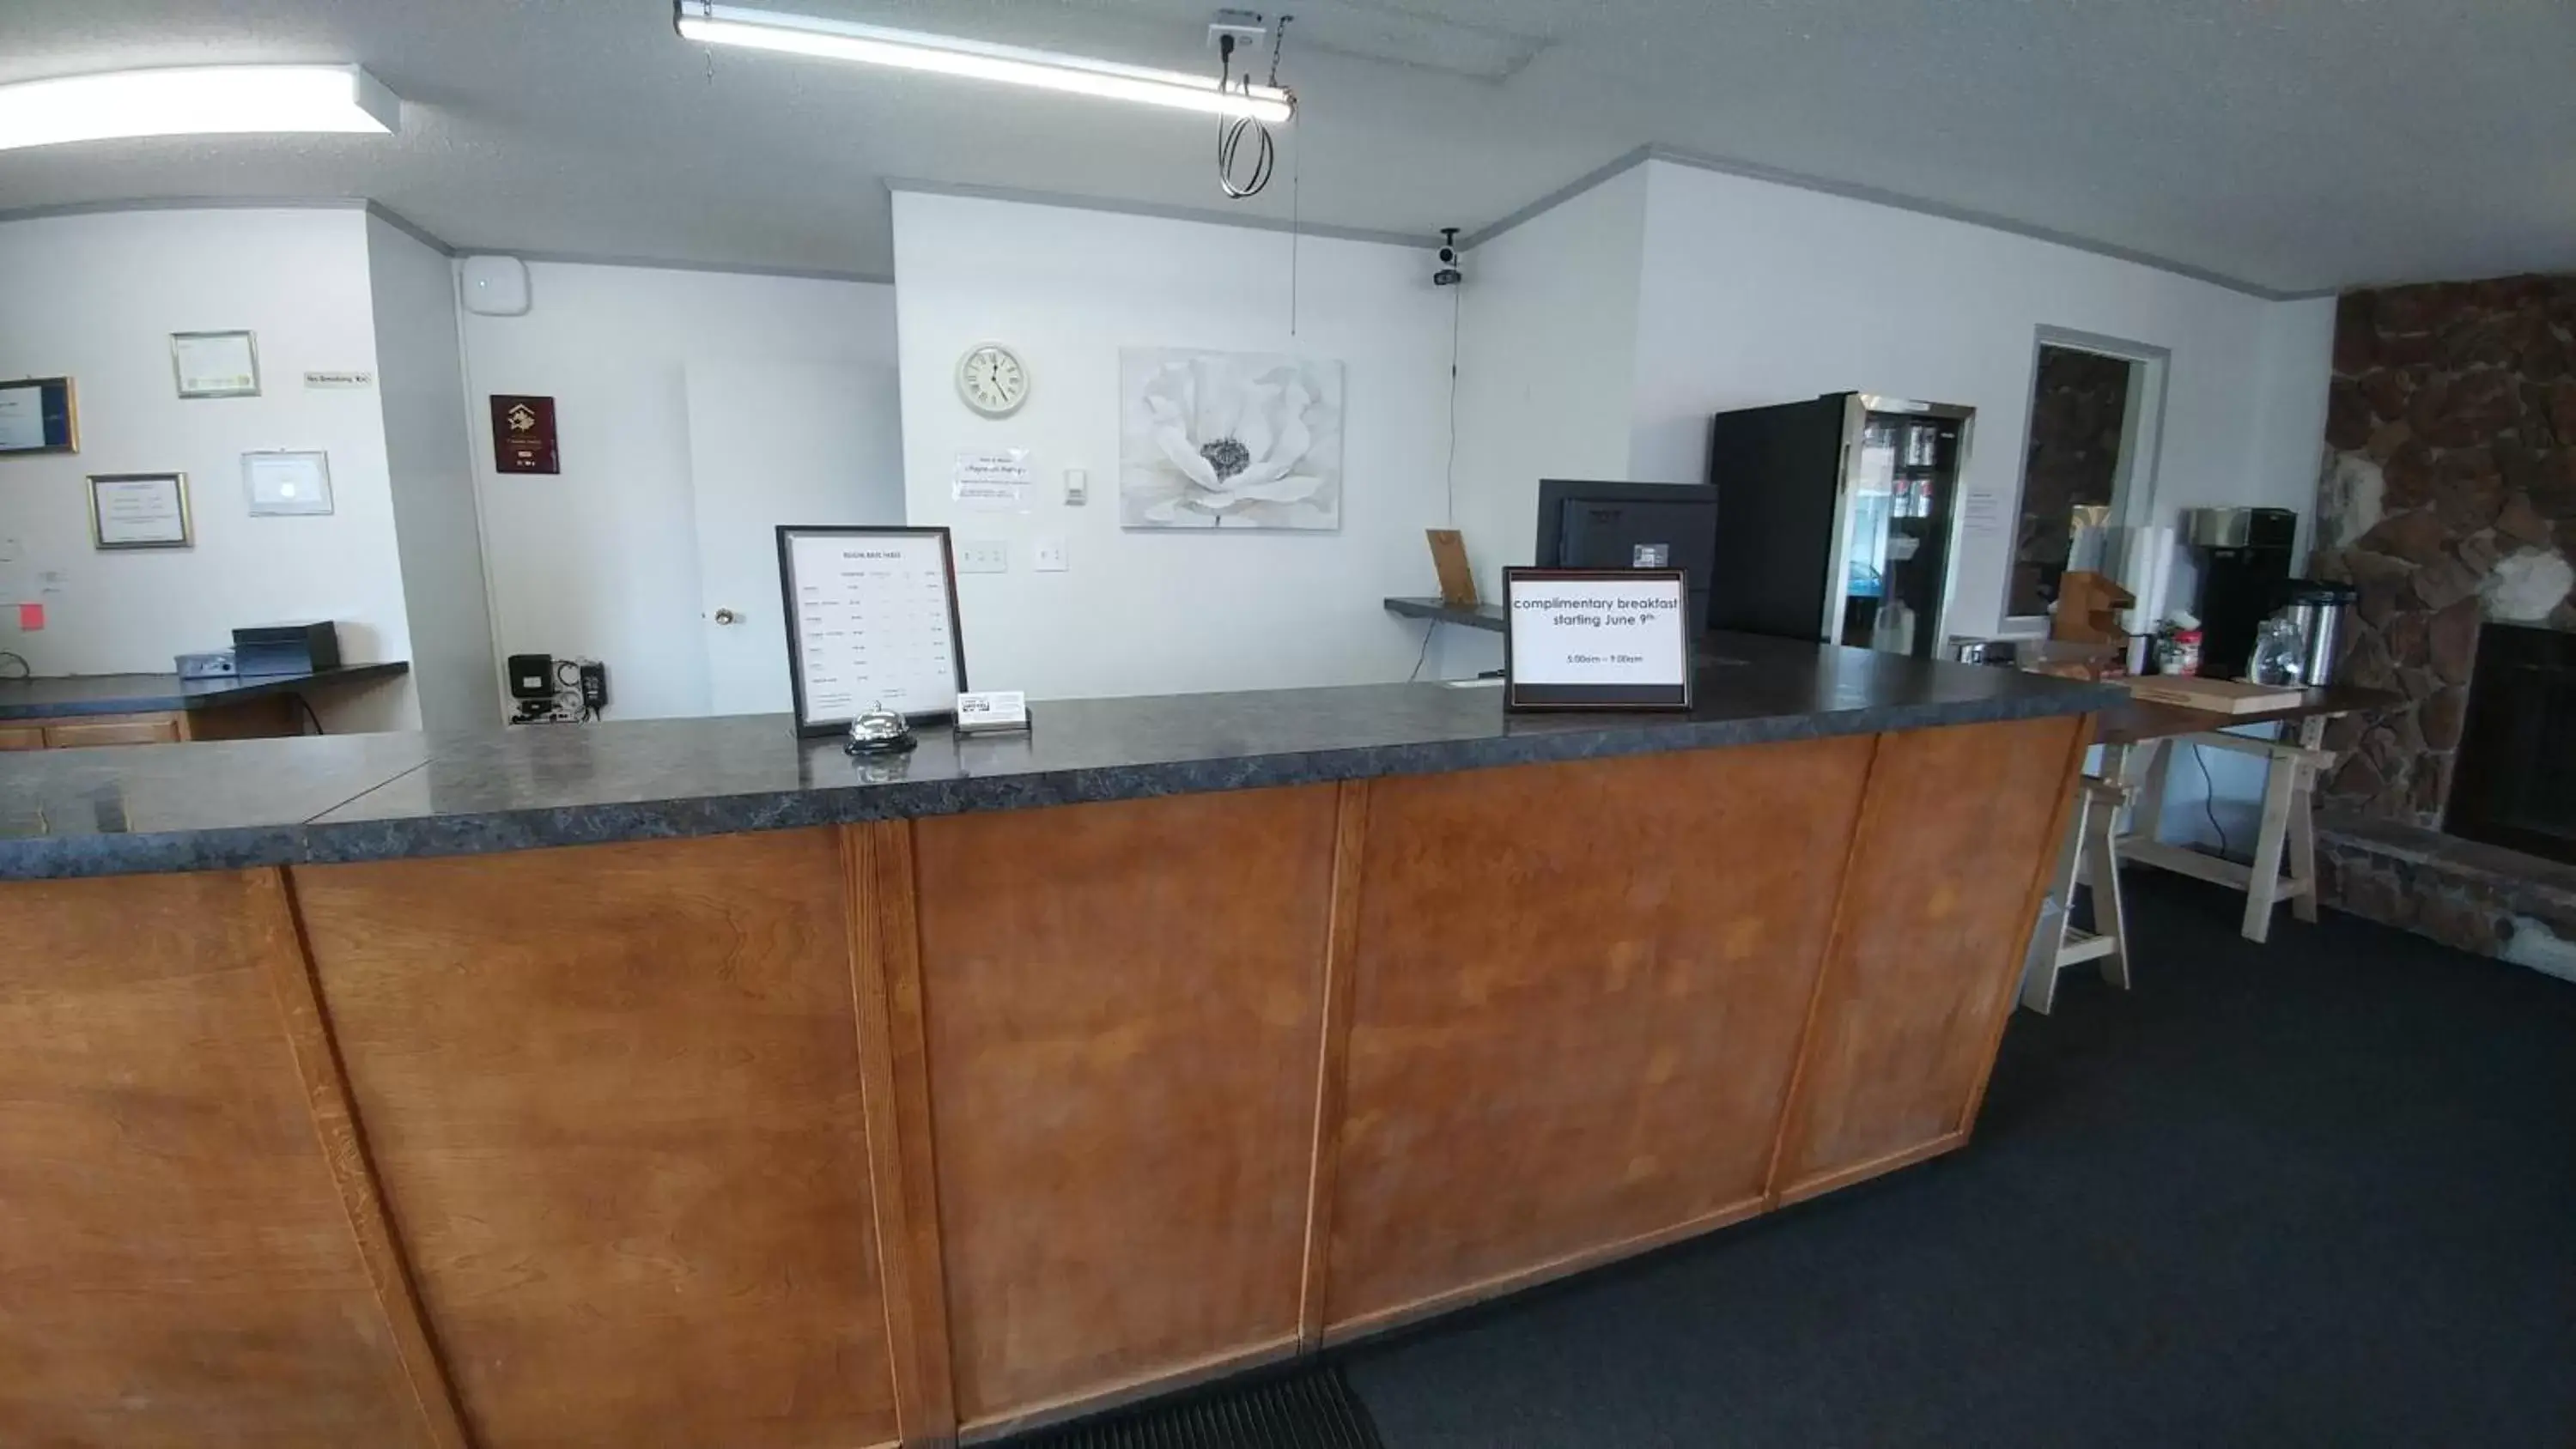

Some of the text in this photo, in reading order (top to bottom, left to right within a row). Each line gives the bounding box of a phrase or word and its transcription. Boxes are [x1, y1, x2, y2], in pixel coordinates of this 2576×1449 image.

[1514, 598, 1678, 611] complimentary breakfast
[1553, 614, 1601, 627] starting
[1605, 615, 1636, 626] June
